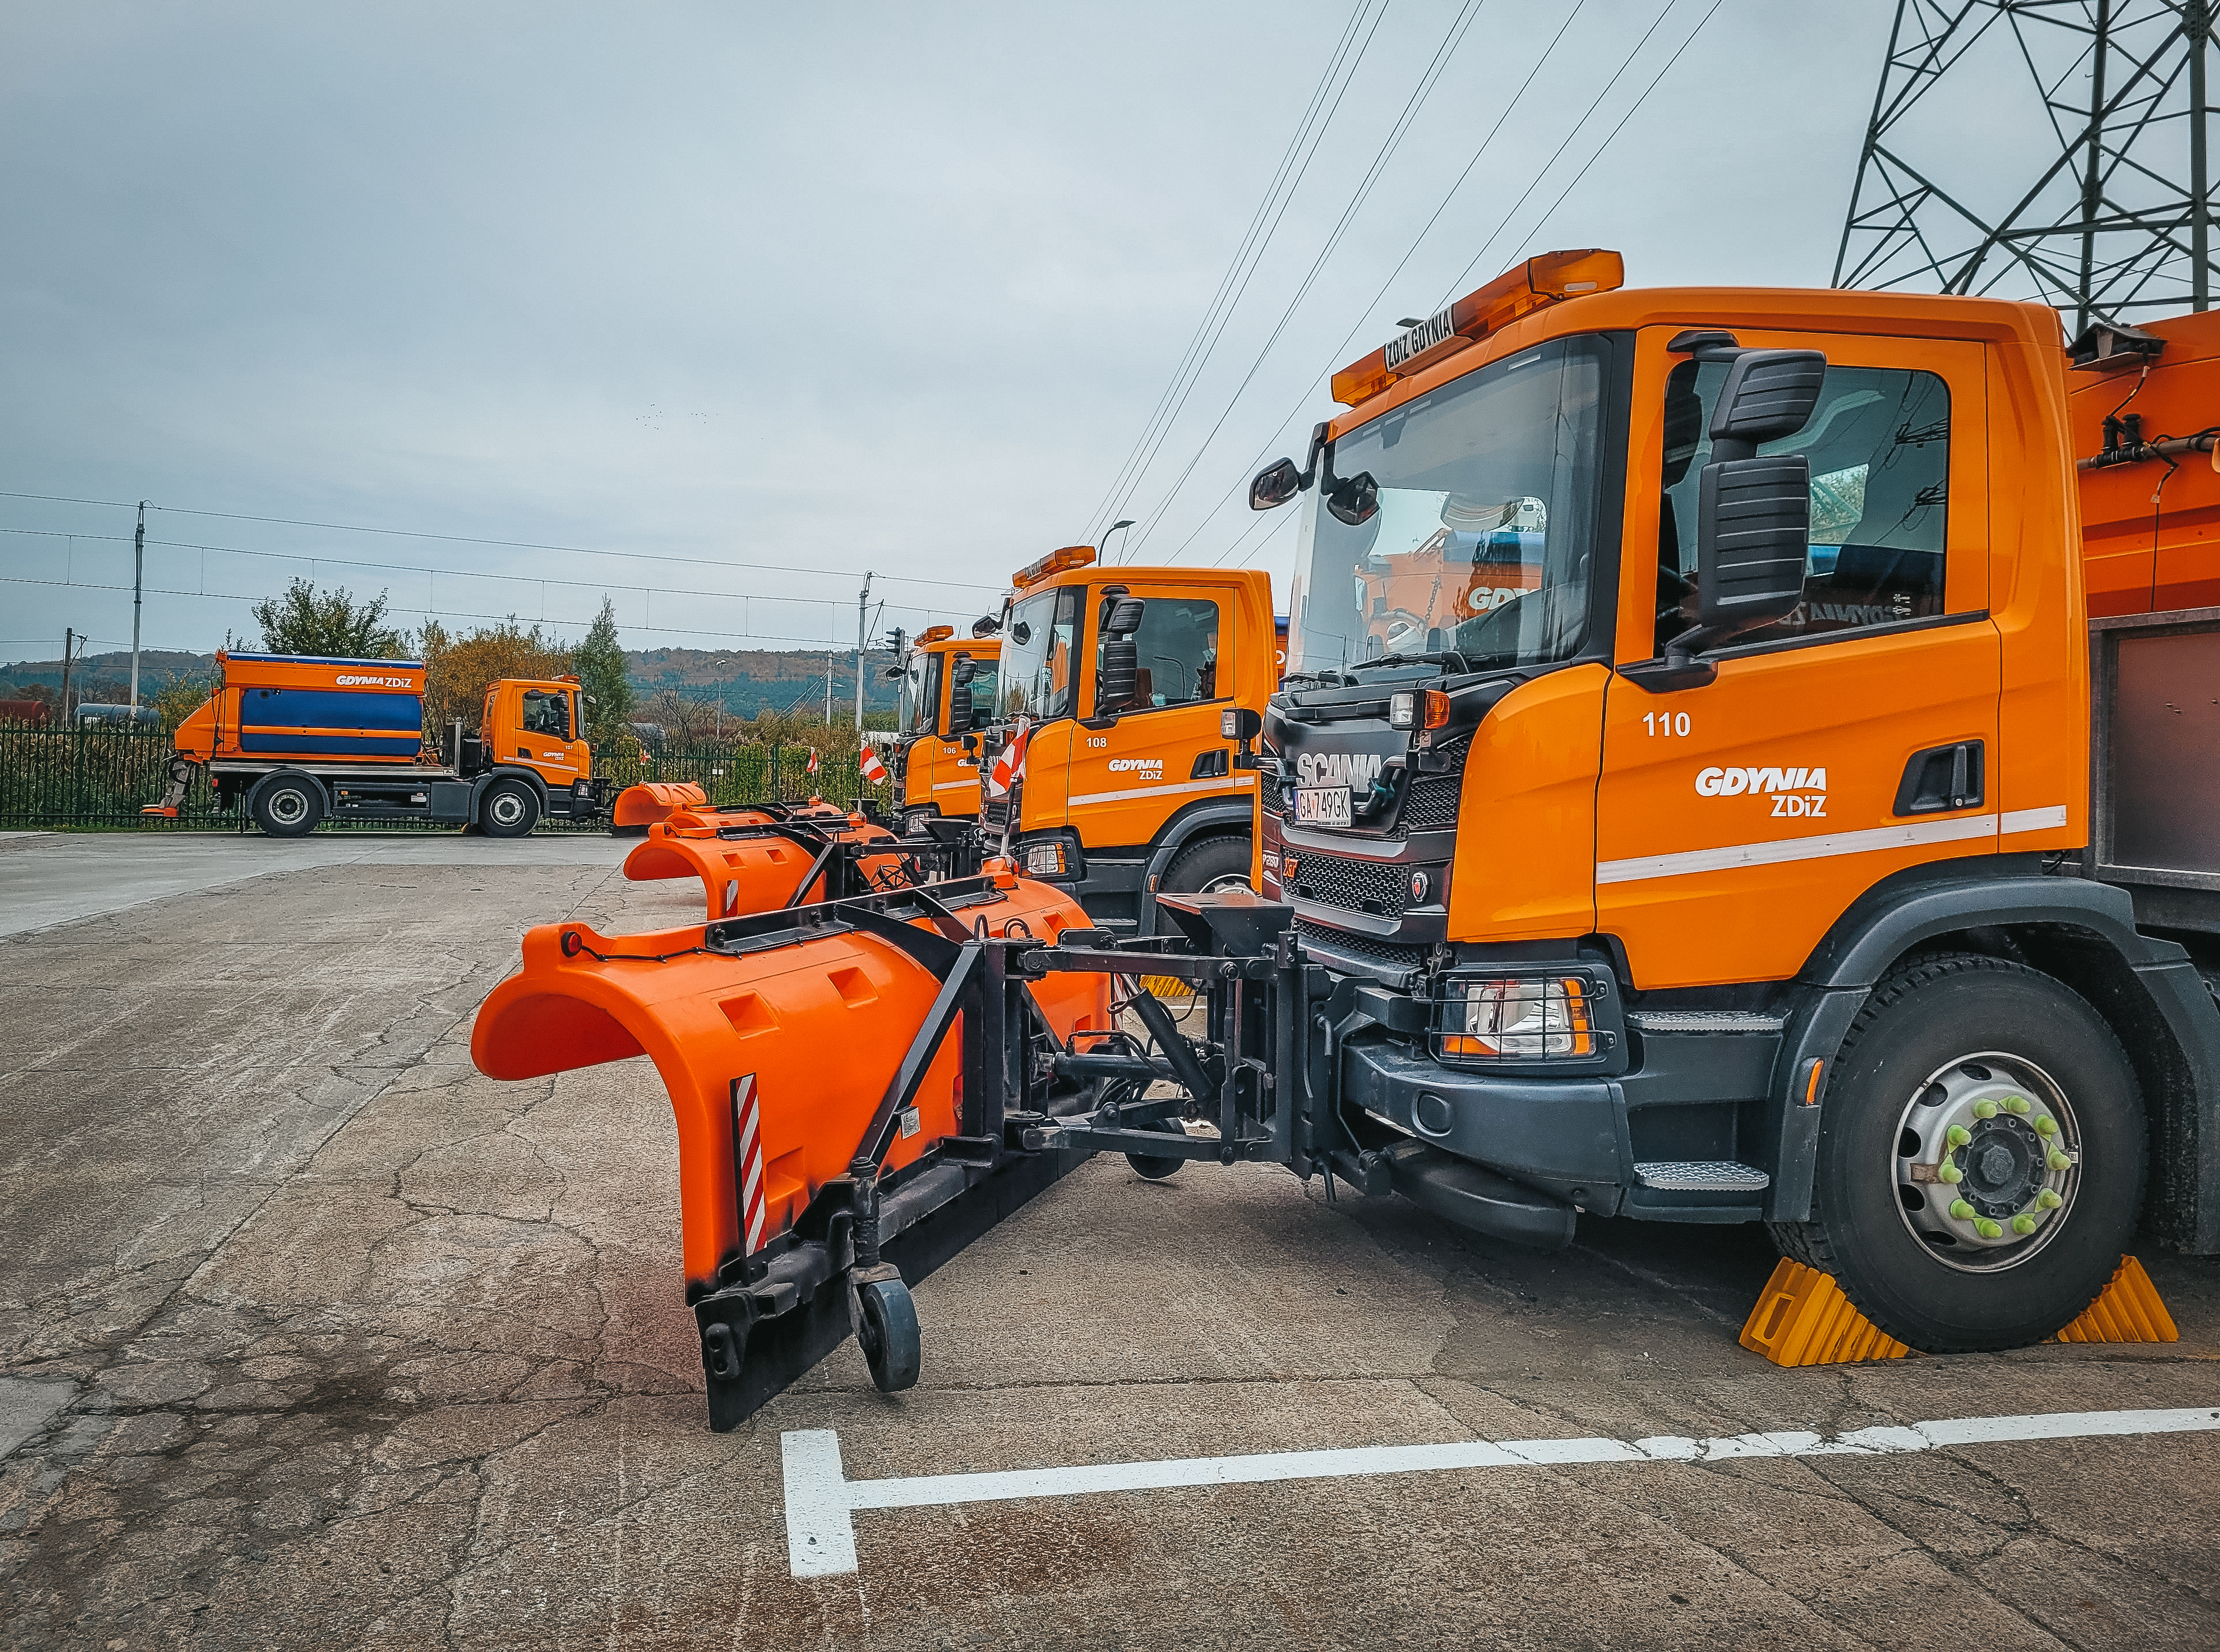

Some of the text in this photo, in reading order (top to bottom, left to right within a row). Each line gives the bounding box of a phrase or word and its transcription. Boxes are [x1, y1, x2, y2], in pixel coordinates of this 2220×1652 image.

[1411, 310, 1452, 355] GDYNIA
[336, 675, 412, 688] GDYNIA ZDiZ
[1642, 712, 1691, 737] 110
[1086, 737, 1107, 748] 108
[1108, 759, 1163, 772] GDYNIA
[1139, 770, 1163, 780] ZDiZ
[1296, 753, 1382, 793] SCANIA
[1695, 767, 1827, 797] GDYNIA
[1299, 790, 1349, 819] GA 749GK
[1769, 795, 1827, 817] ZDiZ
